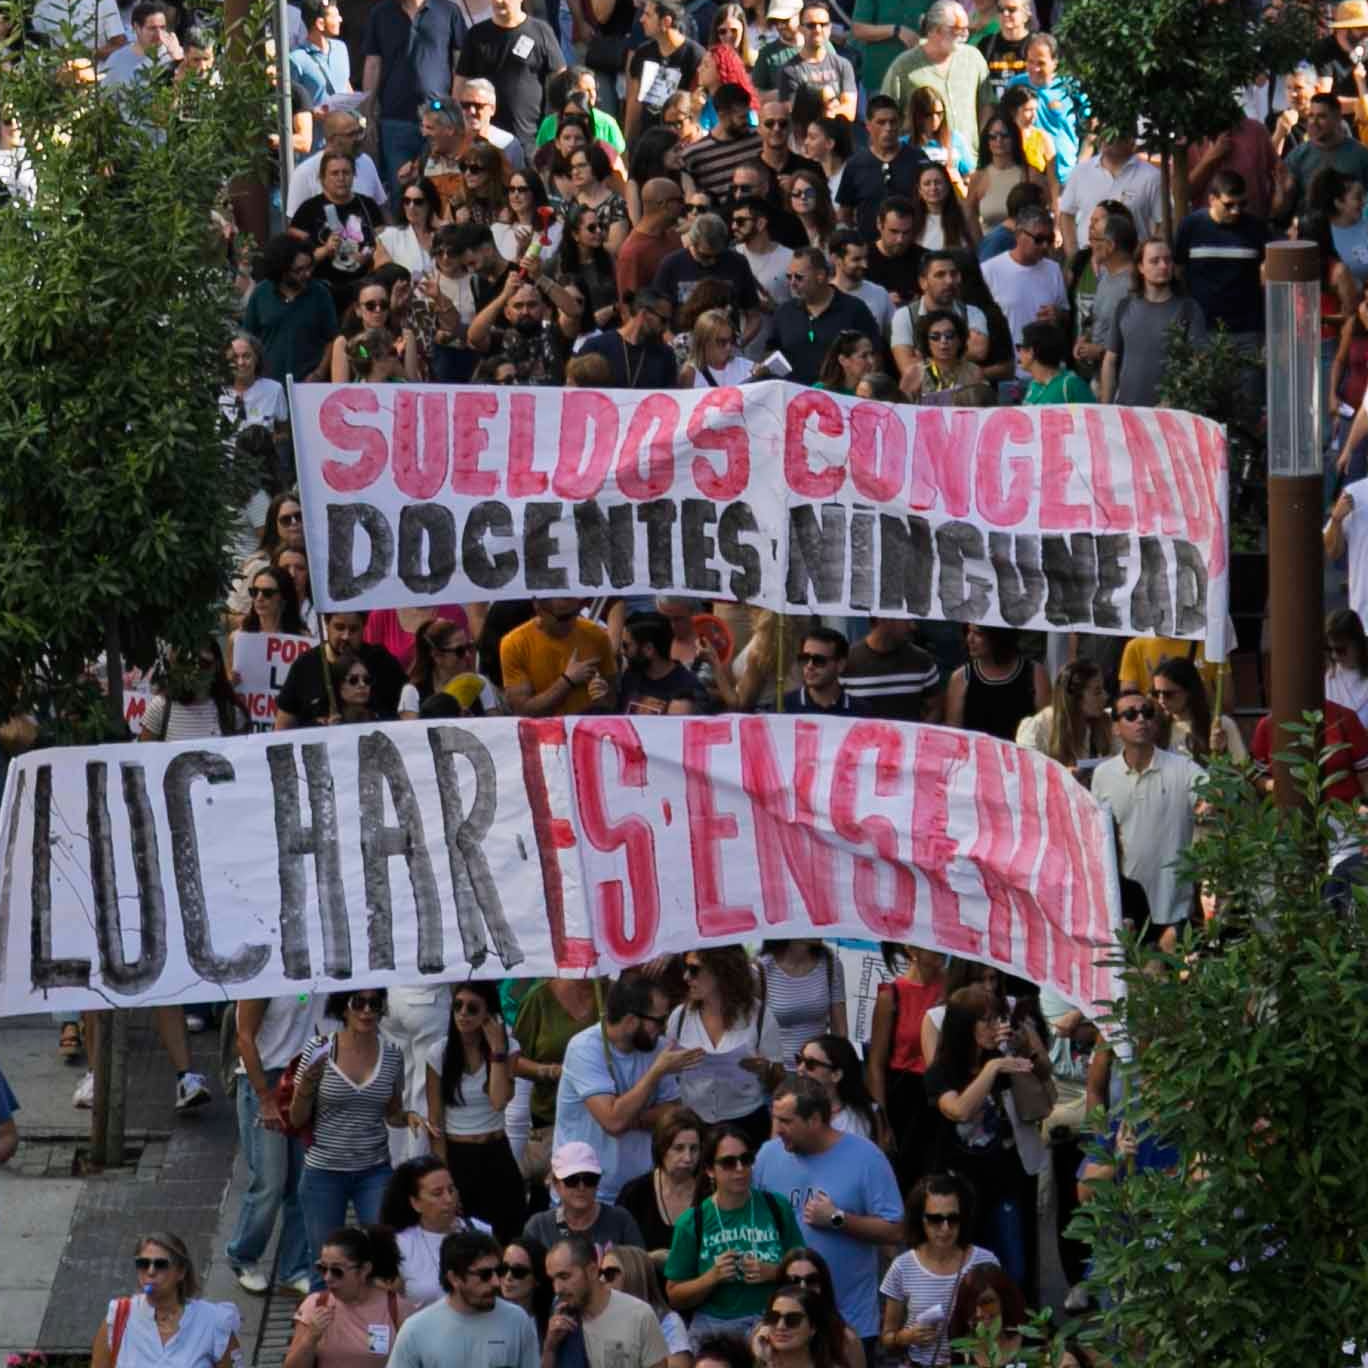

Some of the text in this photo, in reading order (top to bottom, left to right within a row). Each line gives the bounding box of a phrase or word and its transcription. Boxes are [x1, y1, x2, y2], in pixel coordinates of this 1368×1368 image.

[318, 387, 752, 502] SUELDOS
[326, 498, 762, 601] DOCENTES
[30, 726, 525, 997] LUCHAR
[518, 718, 660, 970] ES
